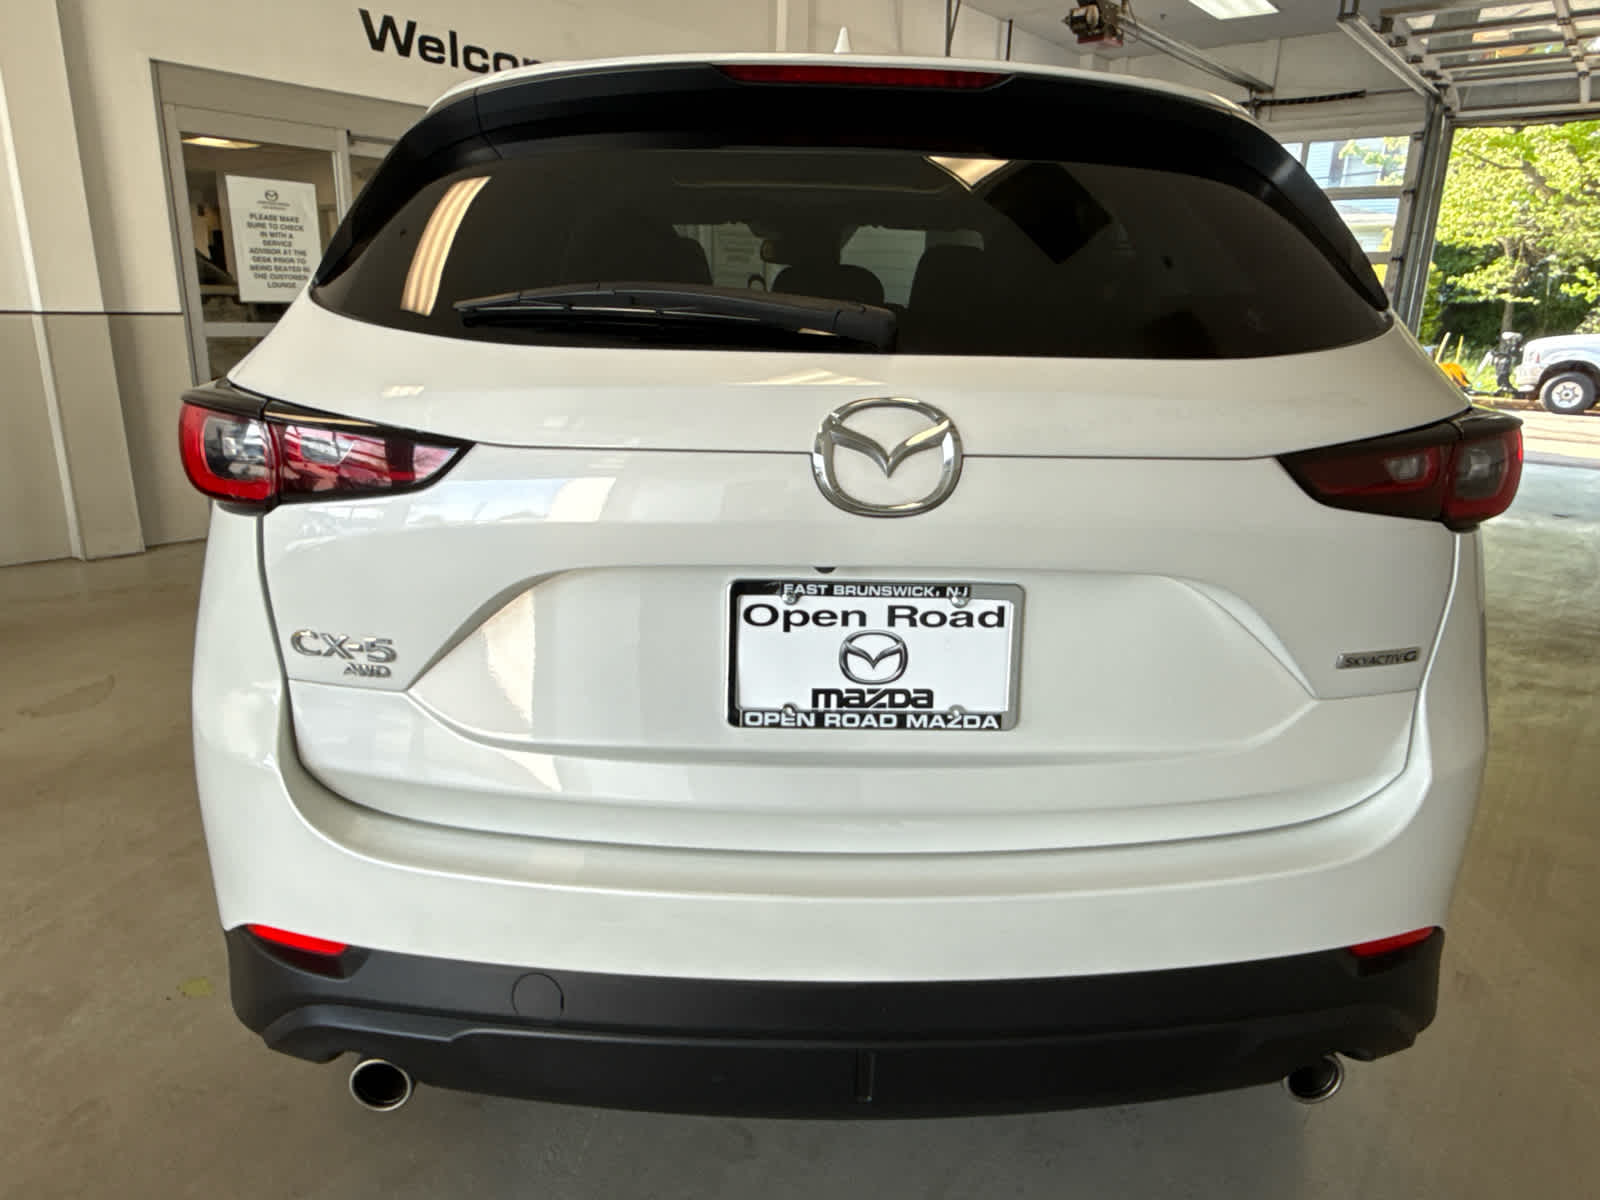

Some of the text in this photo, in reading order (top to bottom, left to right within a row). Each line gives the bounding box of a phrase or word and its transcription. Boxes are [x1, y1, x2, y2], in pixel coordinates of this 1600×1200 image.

[358, 7, 542, 73] Welco
[249, 213, 299, 223] PLEASE MAKE
[280, 224, 304, 232] CHECK
[283, 248, 292, 256] AT
[250, 264, 272, 272] BEING
[270, 272, 308, 280] CUSTOMER
[783, 584, 828, 595] EAST
[833, 584, 941, 597] BRUNSWICK,
[743, 603, 1005, 632] Open Road
[291, 630, 397, 663] CX-5
[344, 663, 392, 678] AWD
[744, 711, 1000, 729] OPEN ROAD MAZDA
